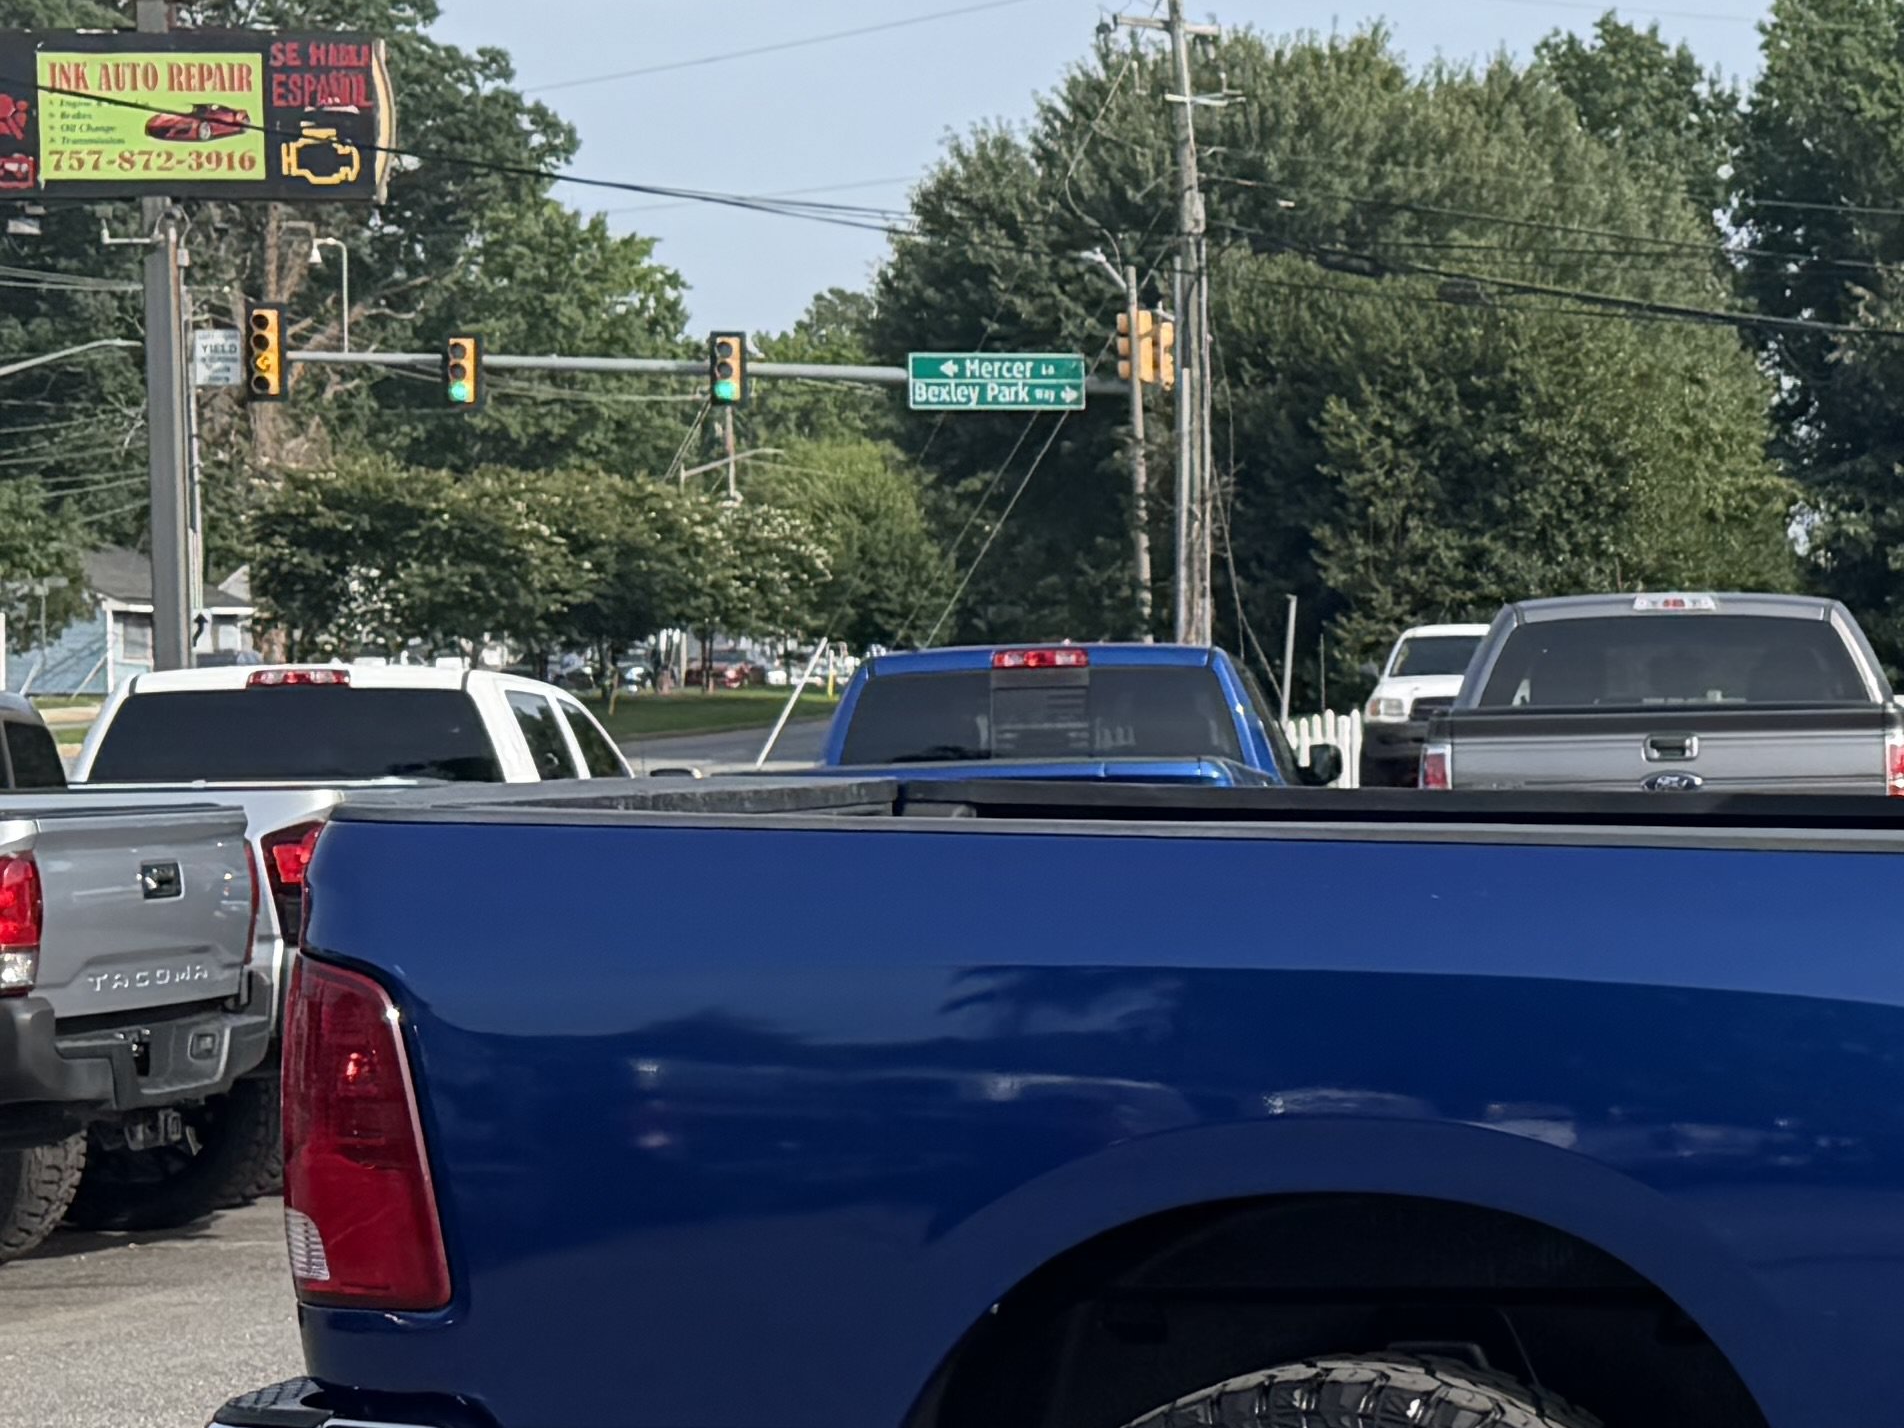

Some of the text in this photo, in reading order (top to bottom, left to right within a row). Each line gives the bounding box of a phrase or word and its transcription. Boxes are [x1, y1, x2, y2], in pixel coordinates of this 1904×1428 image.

[270, 41, 302, 68] SE
[48, 61, 253, 92] INK AUTO REPAIR
[49, 150, 257, 172] 757-872-3916
[965, 359, 1034, 379] Mercer
[914, 382, 980, 406] Bexley
[987, 382, 1030, 403] Park
[88, 965, 208, 992] TACOMA
